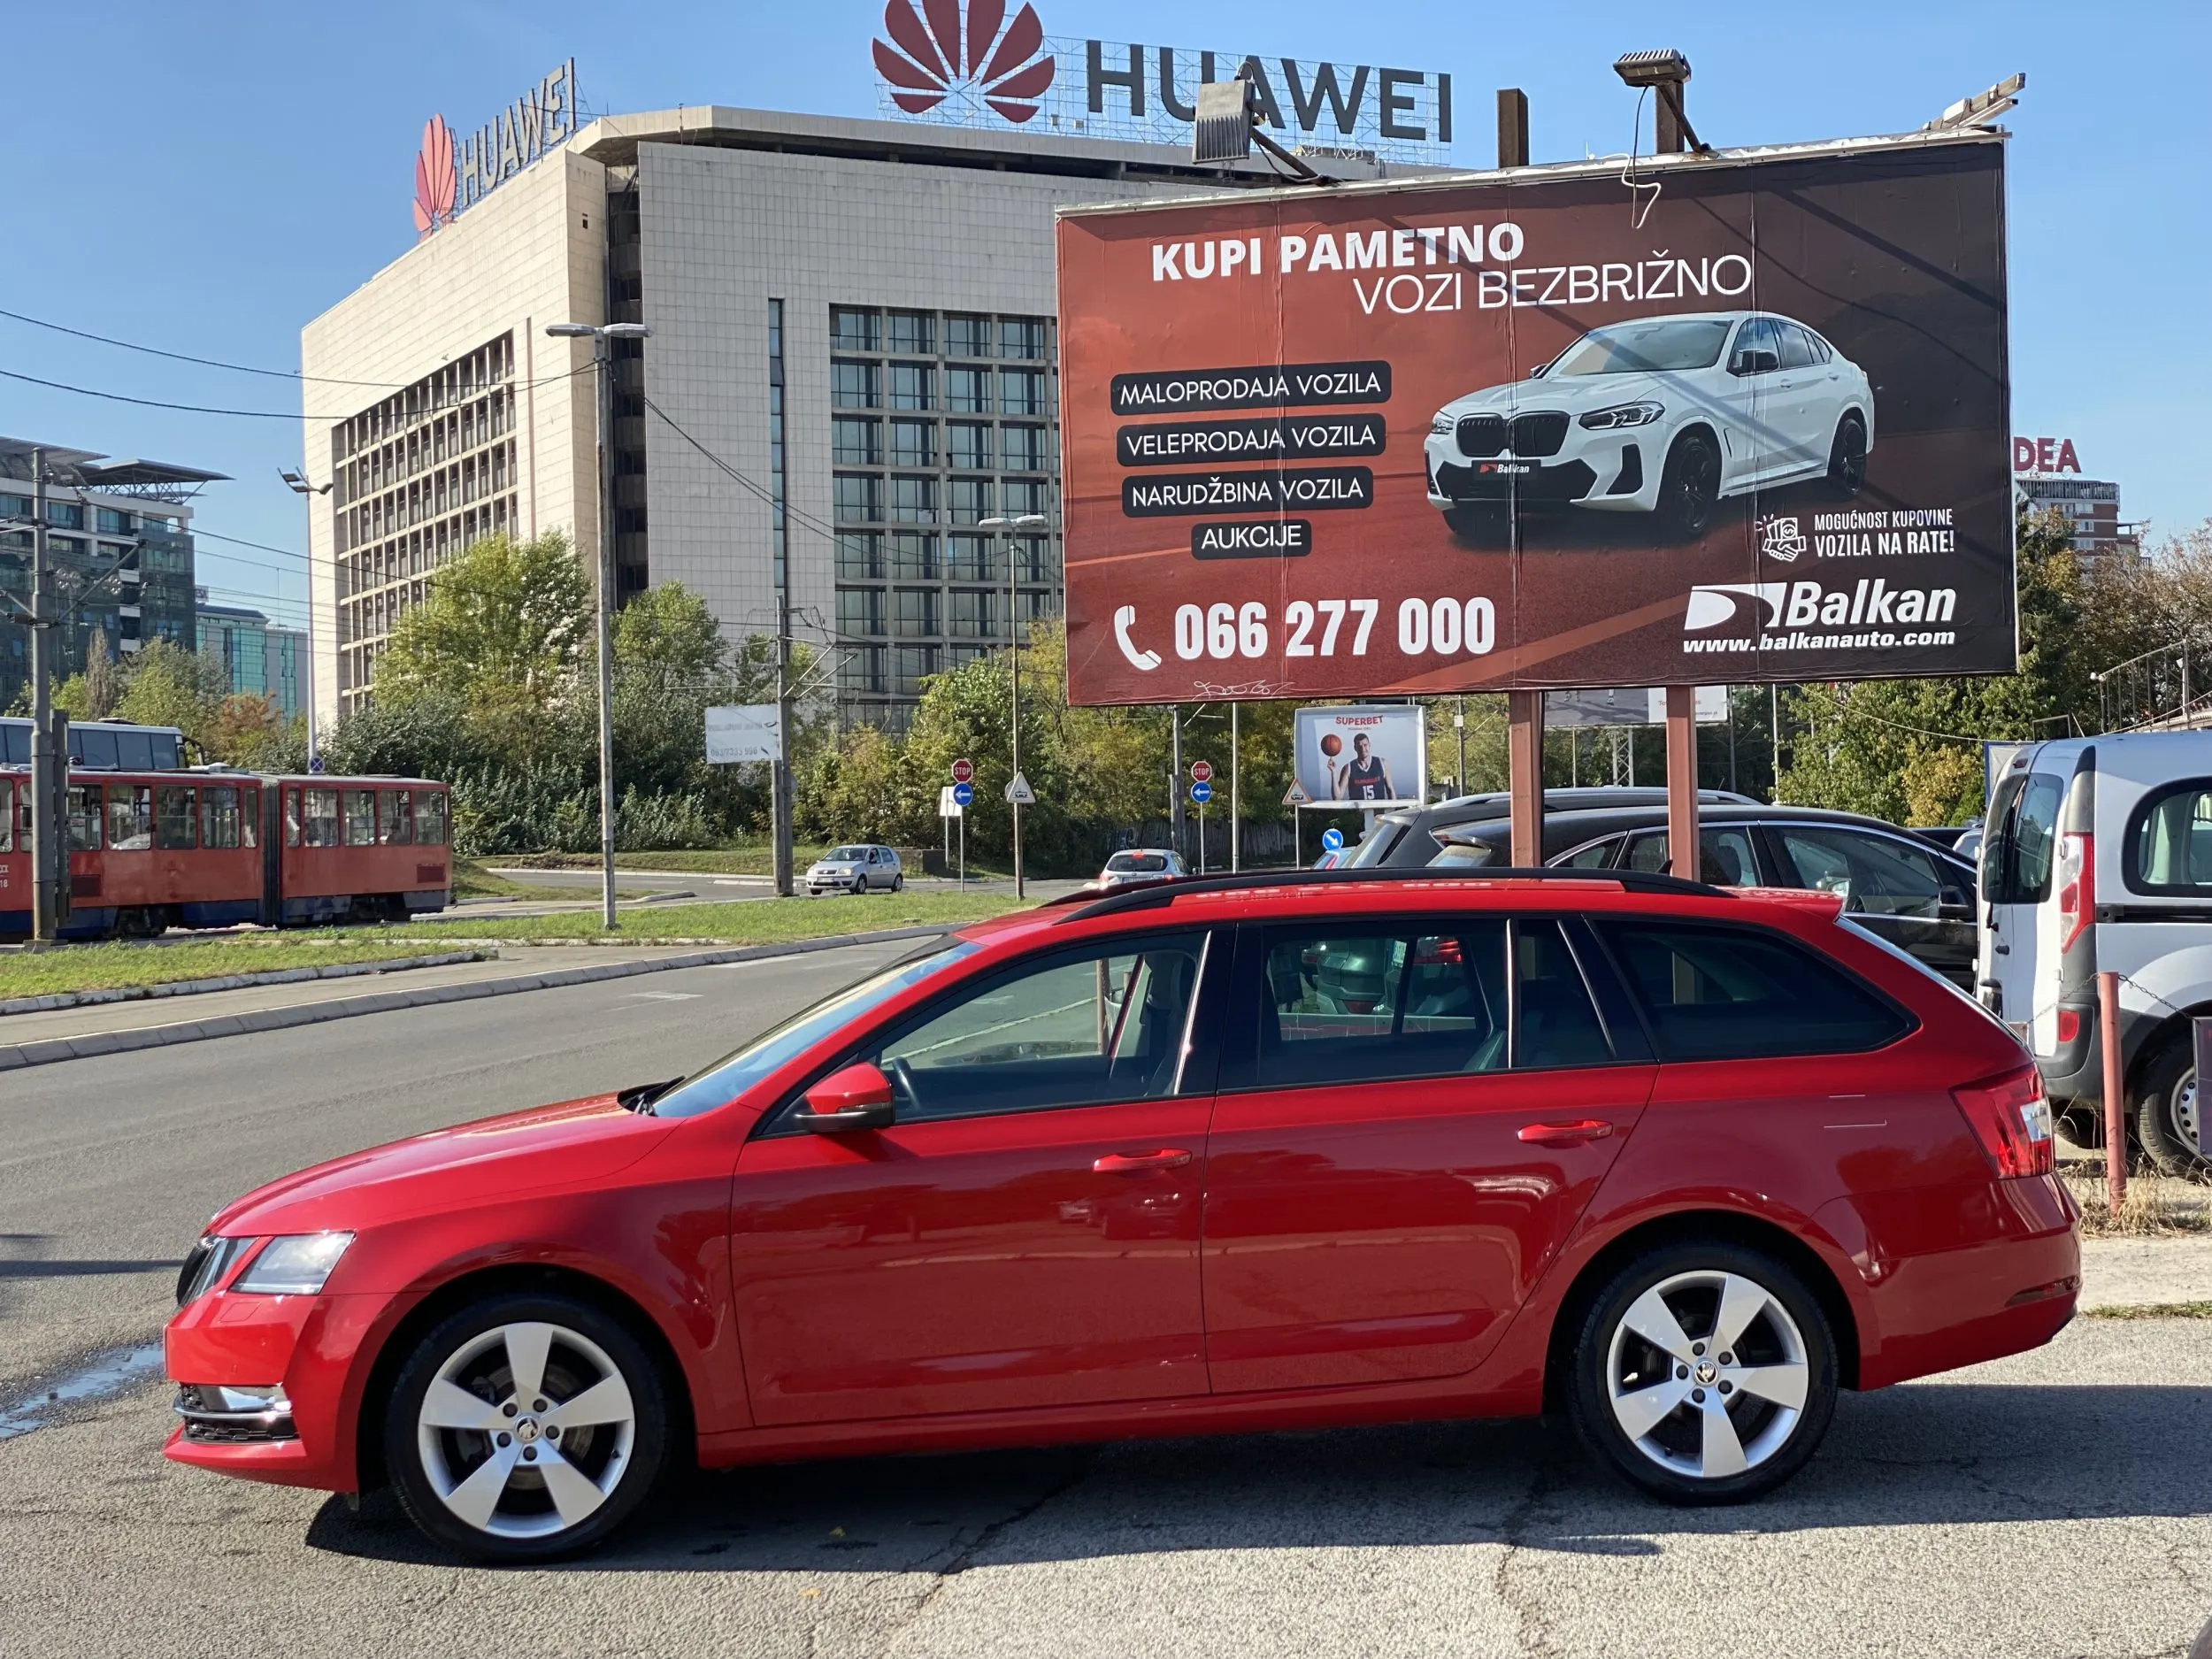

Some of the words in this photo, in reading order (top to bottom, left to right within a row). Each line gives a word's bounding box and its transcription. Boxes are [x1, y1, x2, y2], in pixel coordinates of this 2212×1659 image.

[1087, 39, 1452, 142] HUAWEI
[461, 57, 575, 207] HUAWEI
[1152, 237, 1262, 281] KUPI
[1280, 222, 1524, 273] PAMETNO
[1353, 273, 1462, 314] VOZI
[1479, 249, 1752, 309] BEZBRIŽNO
[1120, 375, 1290, 405] MALOPRODAJA
[1296, 372, 1381, 396] VOZILA
[1126, 428, 1285, 456] VELEPRODAJA
[1292, 424, 1376, 449] VOZILA
[1497, 464, 1530, 473] Balkan
[1133, 476, 1272, 507] NARUDŽBINA
[1279, 477, 1364, 501] VOZILA
[1815, 510, 1888, 531] MOGUĆNOST
[1892, 508, 1953, 528] KUPOVINE
[1201, 525, 1302, 549] AUKCIJE
[1815, 533, 1871, 557] VOZILA
[1878, 532, 1902, 555] NA
[1907, 530, 1955, 554] RATE!
[1786, 578, 1956, 627] Balkan
[1174, 601, 1269, 661] 066
[1285, 597, 1379, 657] 277
[1398, 596, 1495, 655] 000
[1683, 631, 1955, 653] www.balkanauto.com
[1336, 715, 1384, 726] SUPERBET
[955, 766, 971, 775] STOP
[1194, 767, 1210, 776] STOP
[1363, 784, 1375, 800] 15
